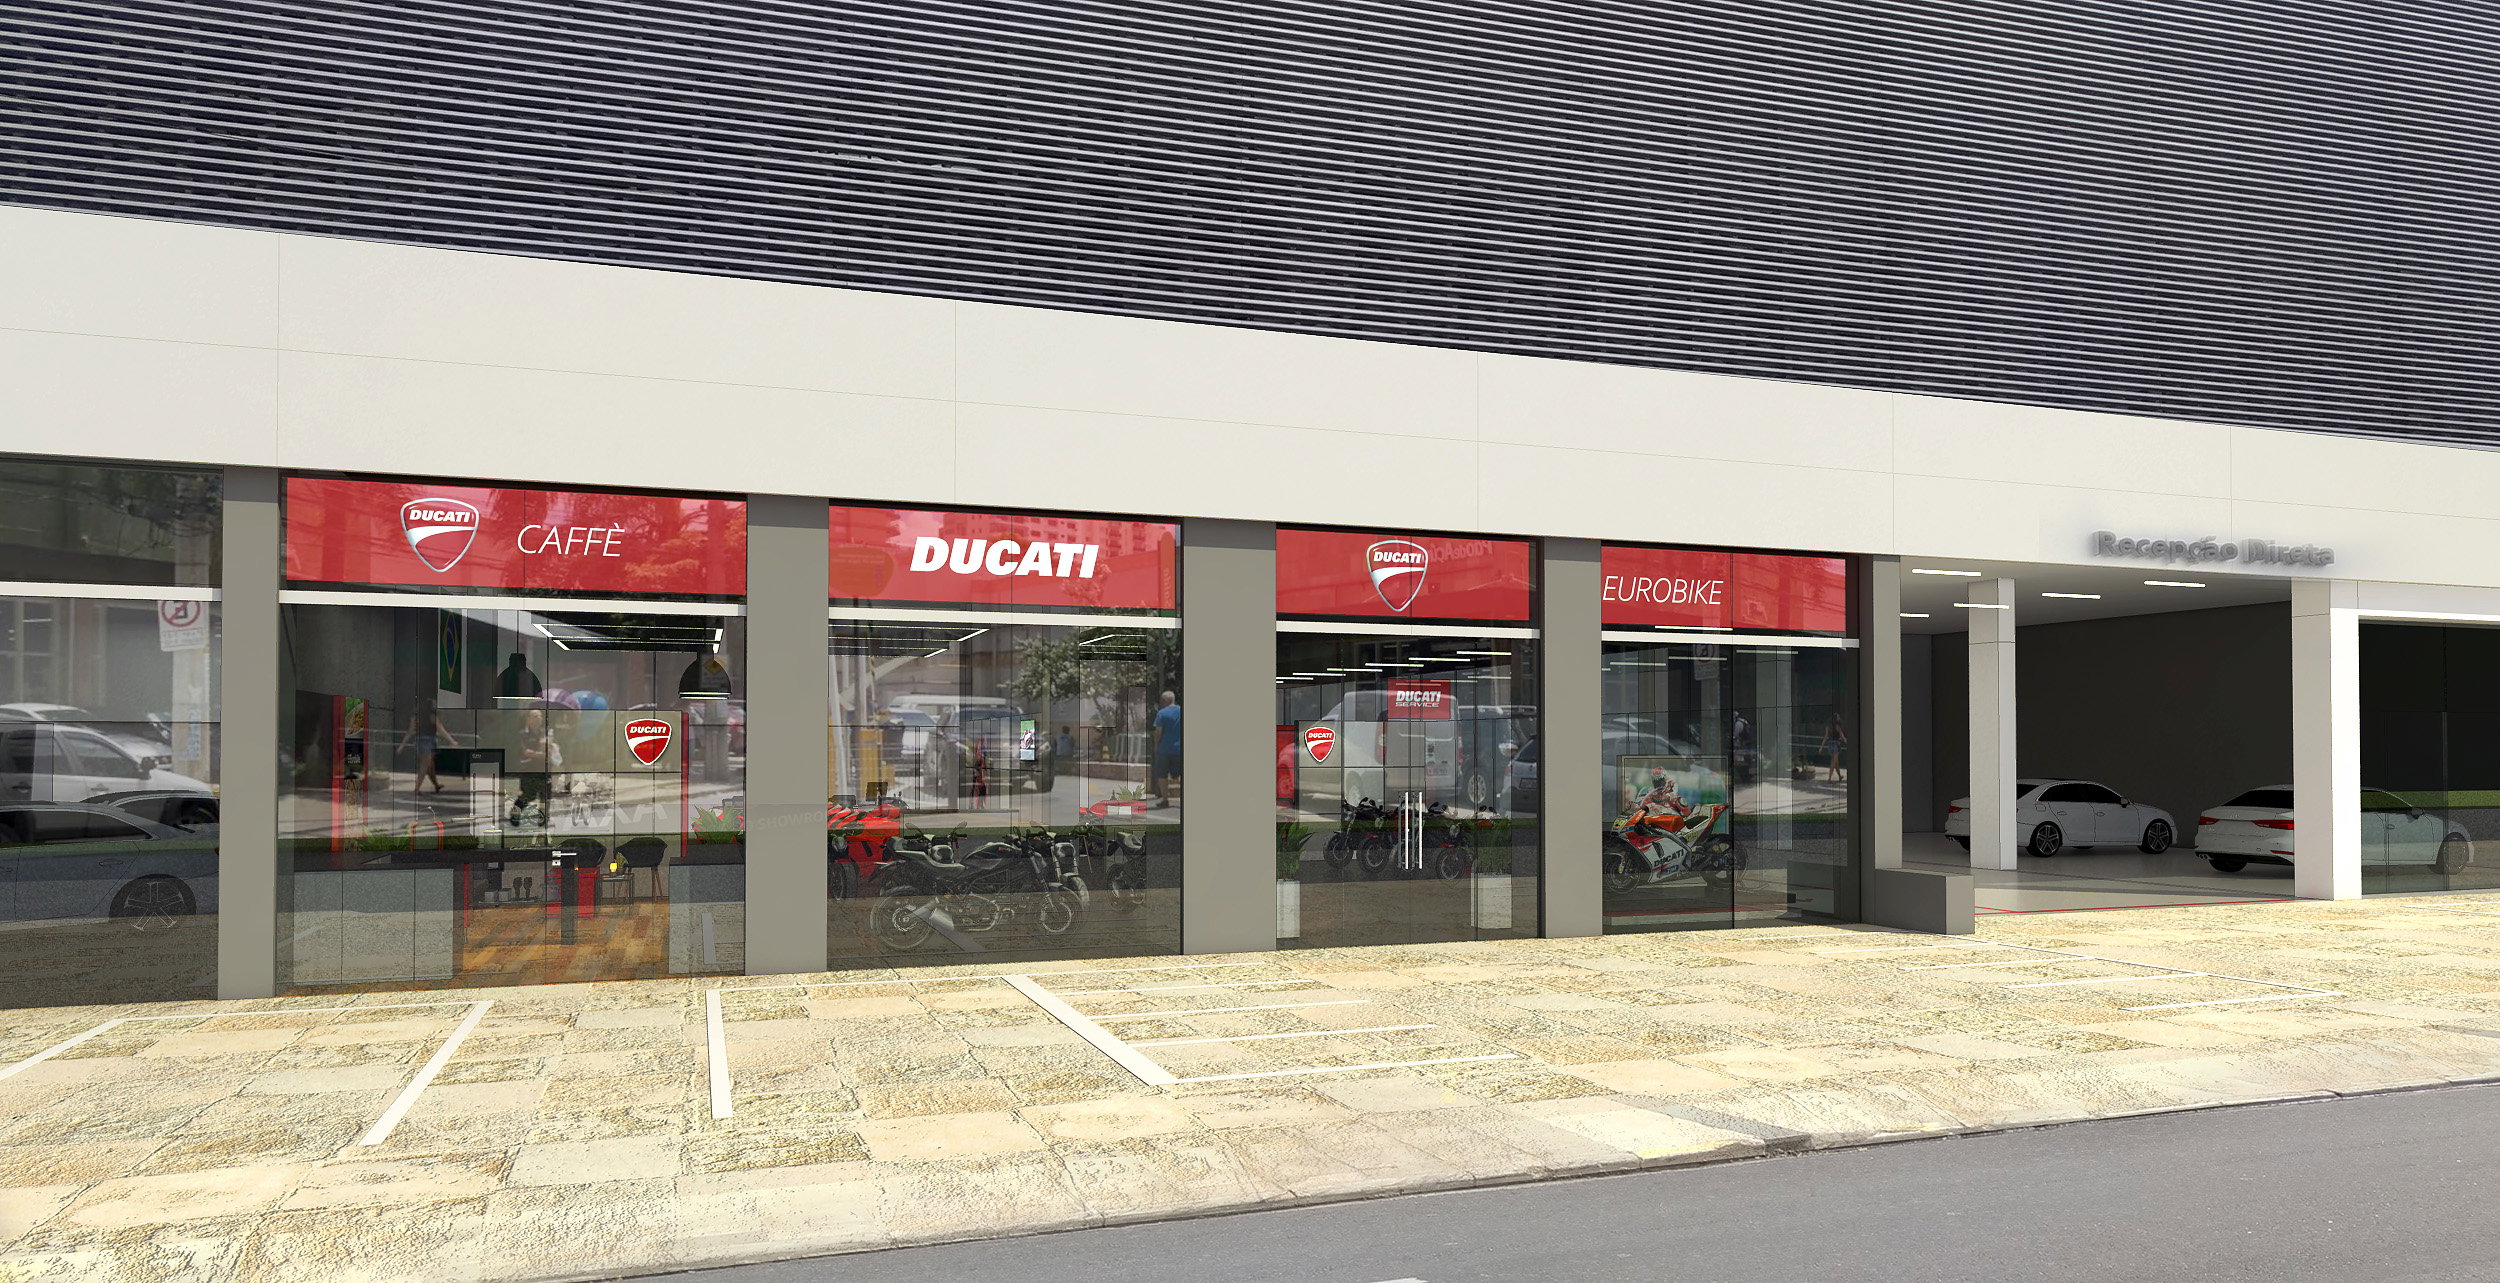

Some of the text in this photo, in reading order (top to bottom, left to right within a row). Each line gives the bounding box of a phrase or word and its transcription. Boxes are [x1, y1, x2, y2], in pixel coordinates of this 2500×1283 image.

[409, 508, 471, 523] DUCATI
[517, 522, 626, 558] CAFFÈ
[2092, 531, 2334, 565] Recepção Direta
[910, 536, 1099, 579] DUCATI
[1373, 551, 1422, 564] DUCATI
[1602, 575, 1724, 605] EUROBIKE
[1395, 690, 1441, 702] DUCATI
[630, 726, 667, 734] DUCATI
